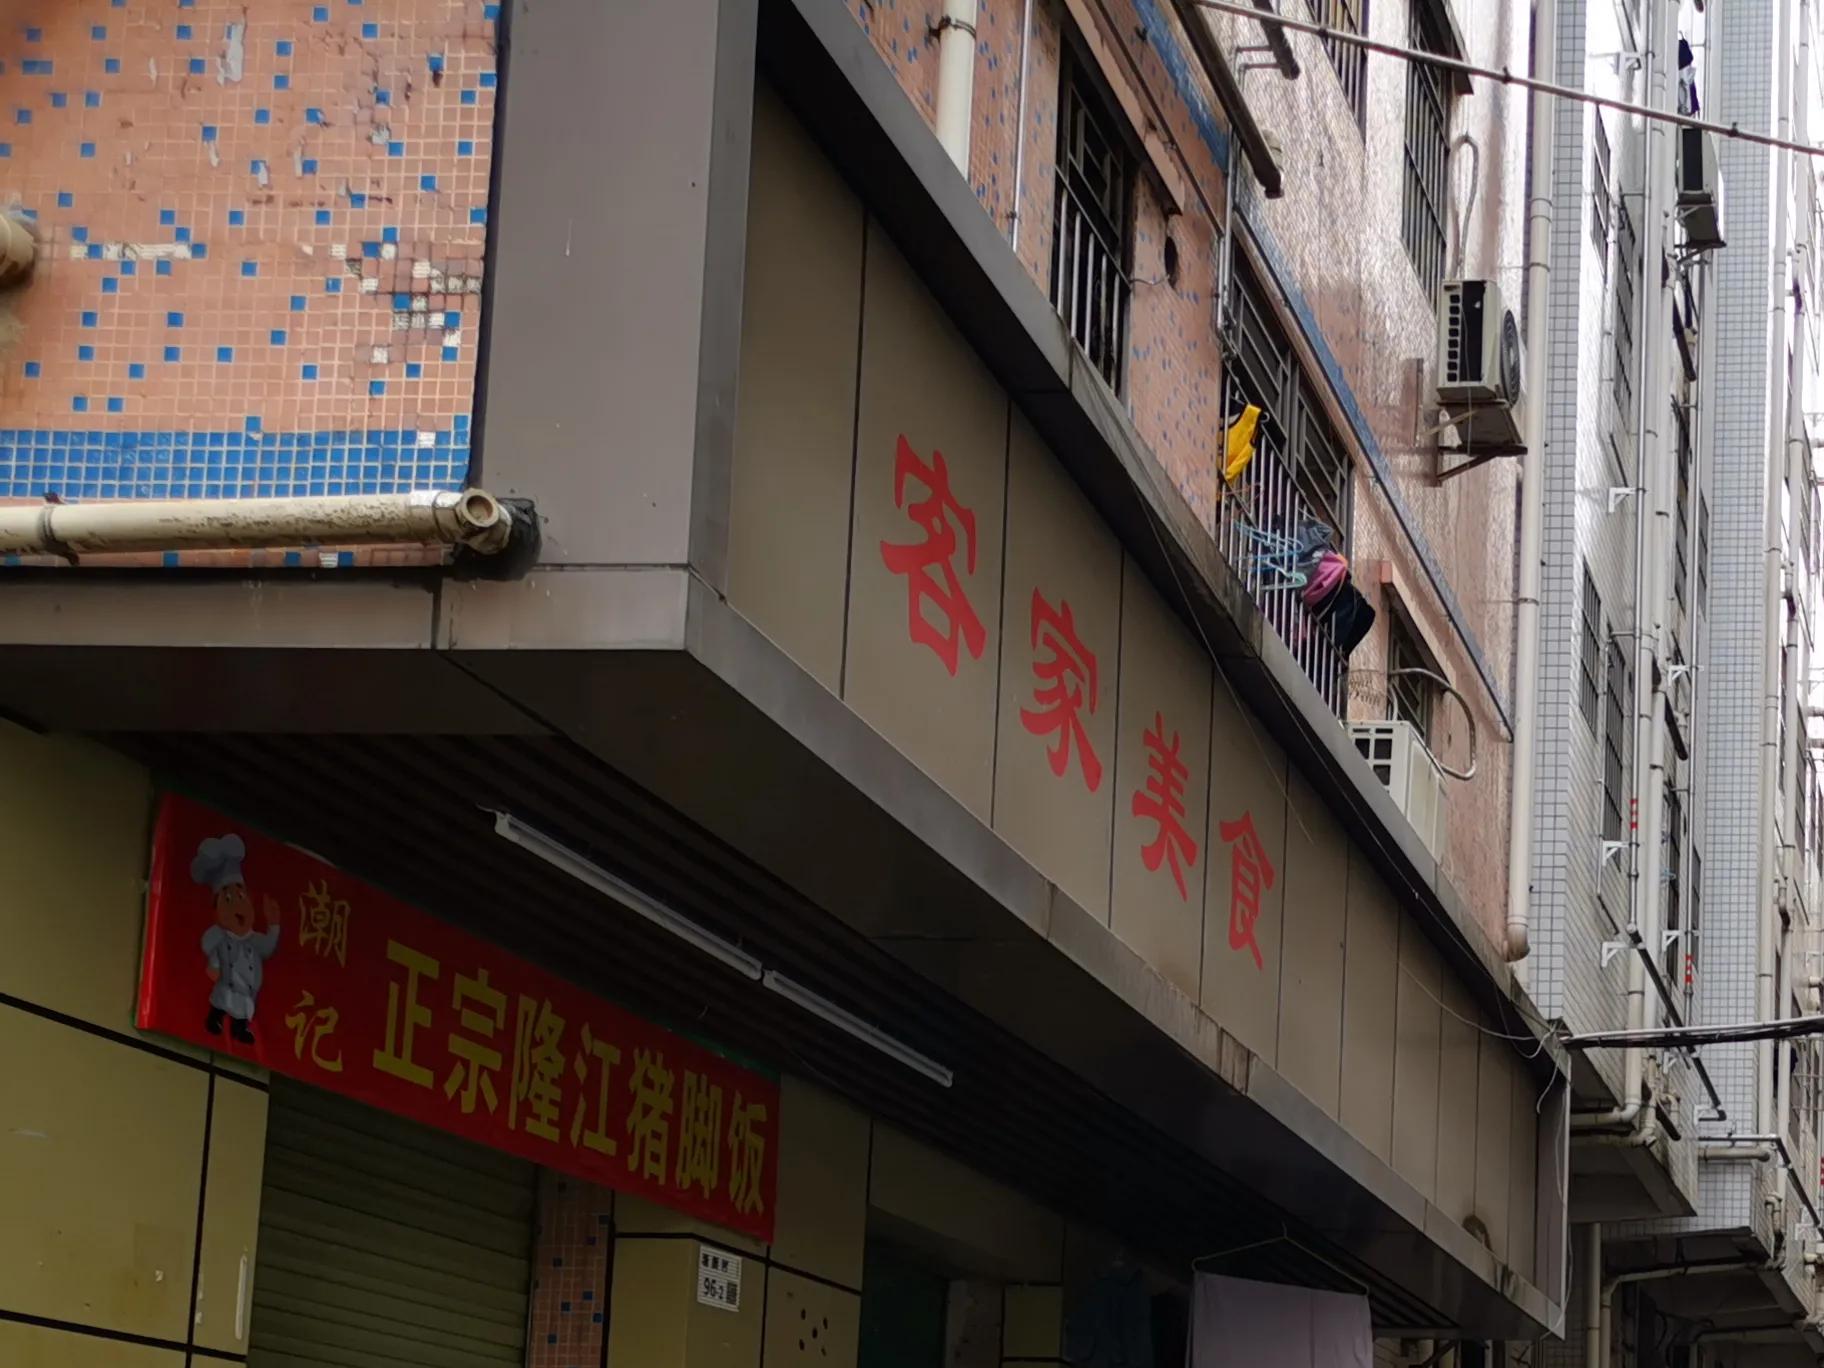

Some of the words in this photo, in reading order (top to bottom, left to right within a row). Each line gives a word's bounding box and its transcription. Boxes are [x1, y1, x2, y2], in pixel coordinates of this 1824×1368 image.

[880, 433, 1275, 970] 客家美食
[373, 939, 765, 1215] 正宗隆江猪脚饭
